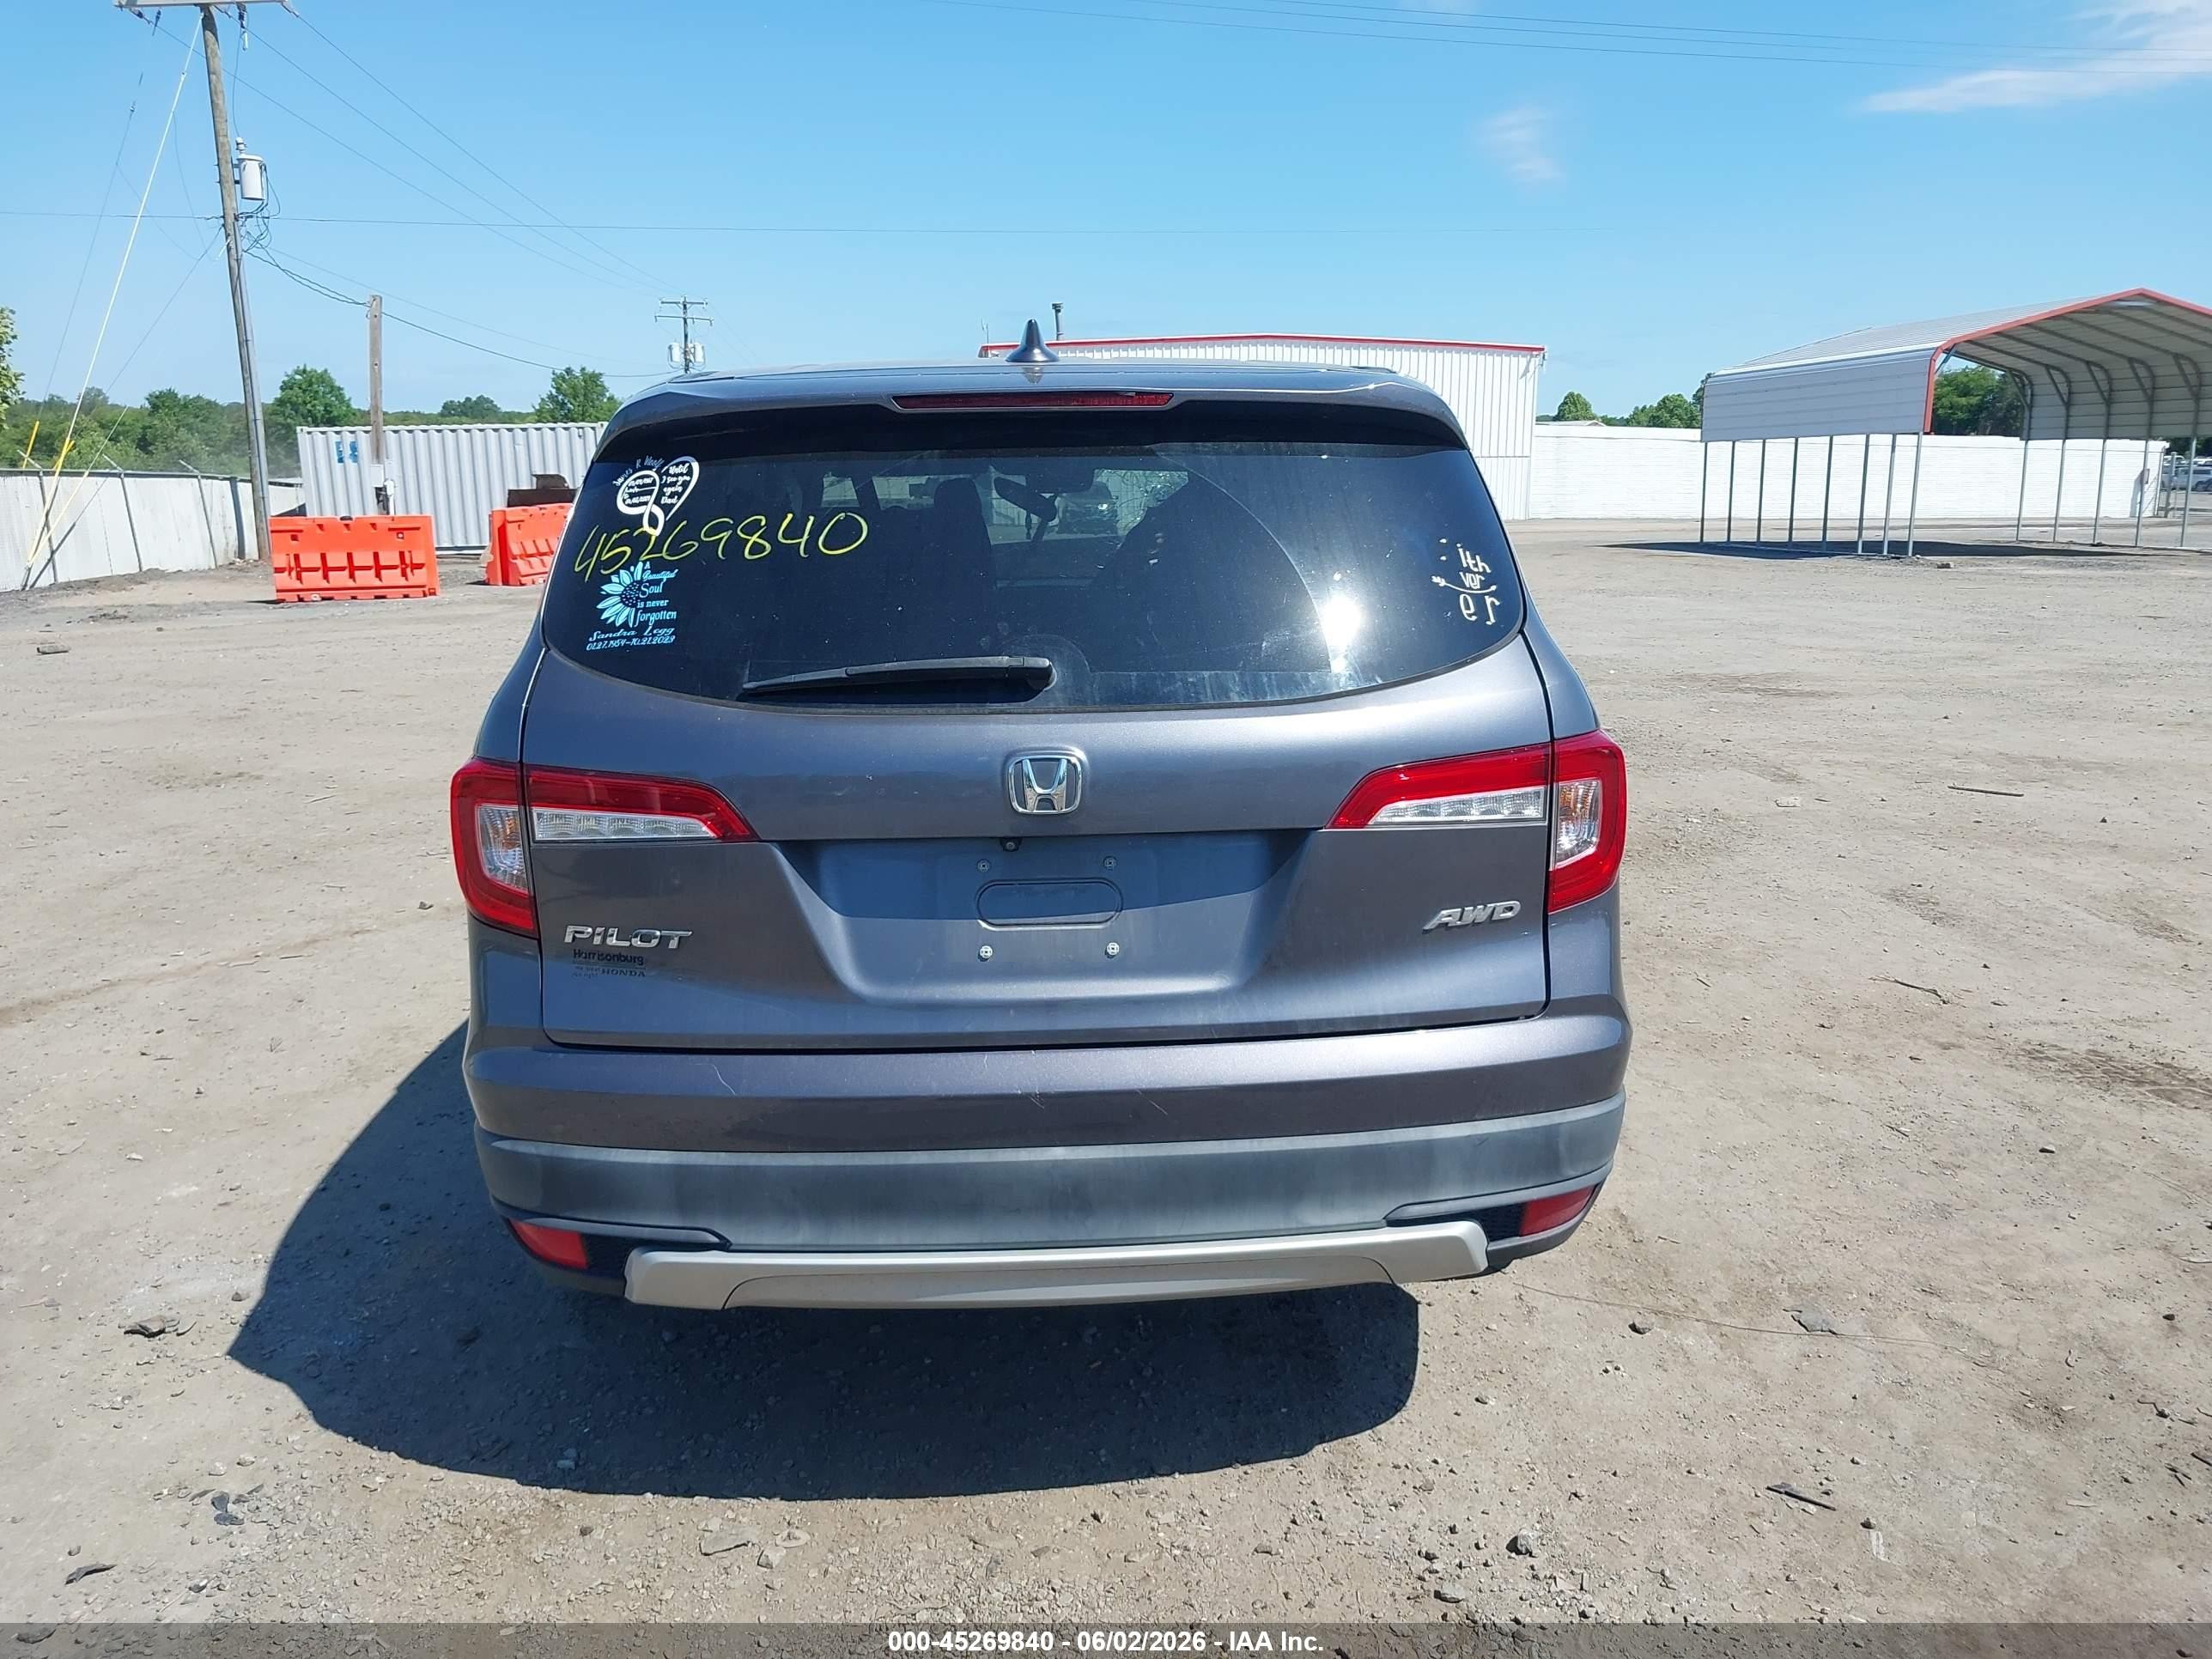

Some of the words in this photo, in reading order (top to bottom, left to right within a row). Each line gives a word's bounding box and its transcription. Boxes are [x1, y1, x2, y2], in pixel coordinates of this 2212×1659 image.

[574, 512, 869, 584] 45269840
[644, 561, 652, 569] A
[639, 580, 665, 599] Soul
[646, 599, 670, 608] never
[634, 610, 678, 628] forgotten
[588, 629, 637, 642] Sandra
[1422, 900, 1522, 931] AWD
[563, 925, 693, 949] PILOT
